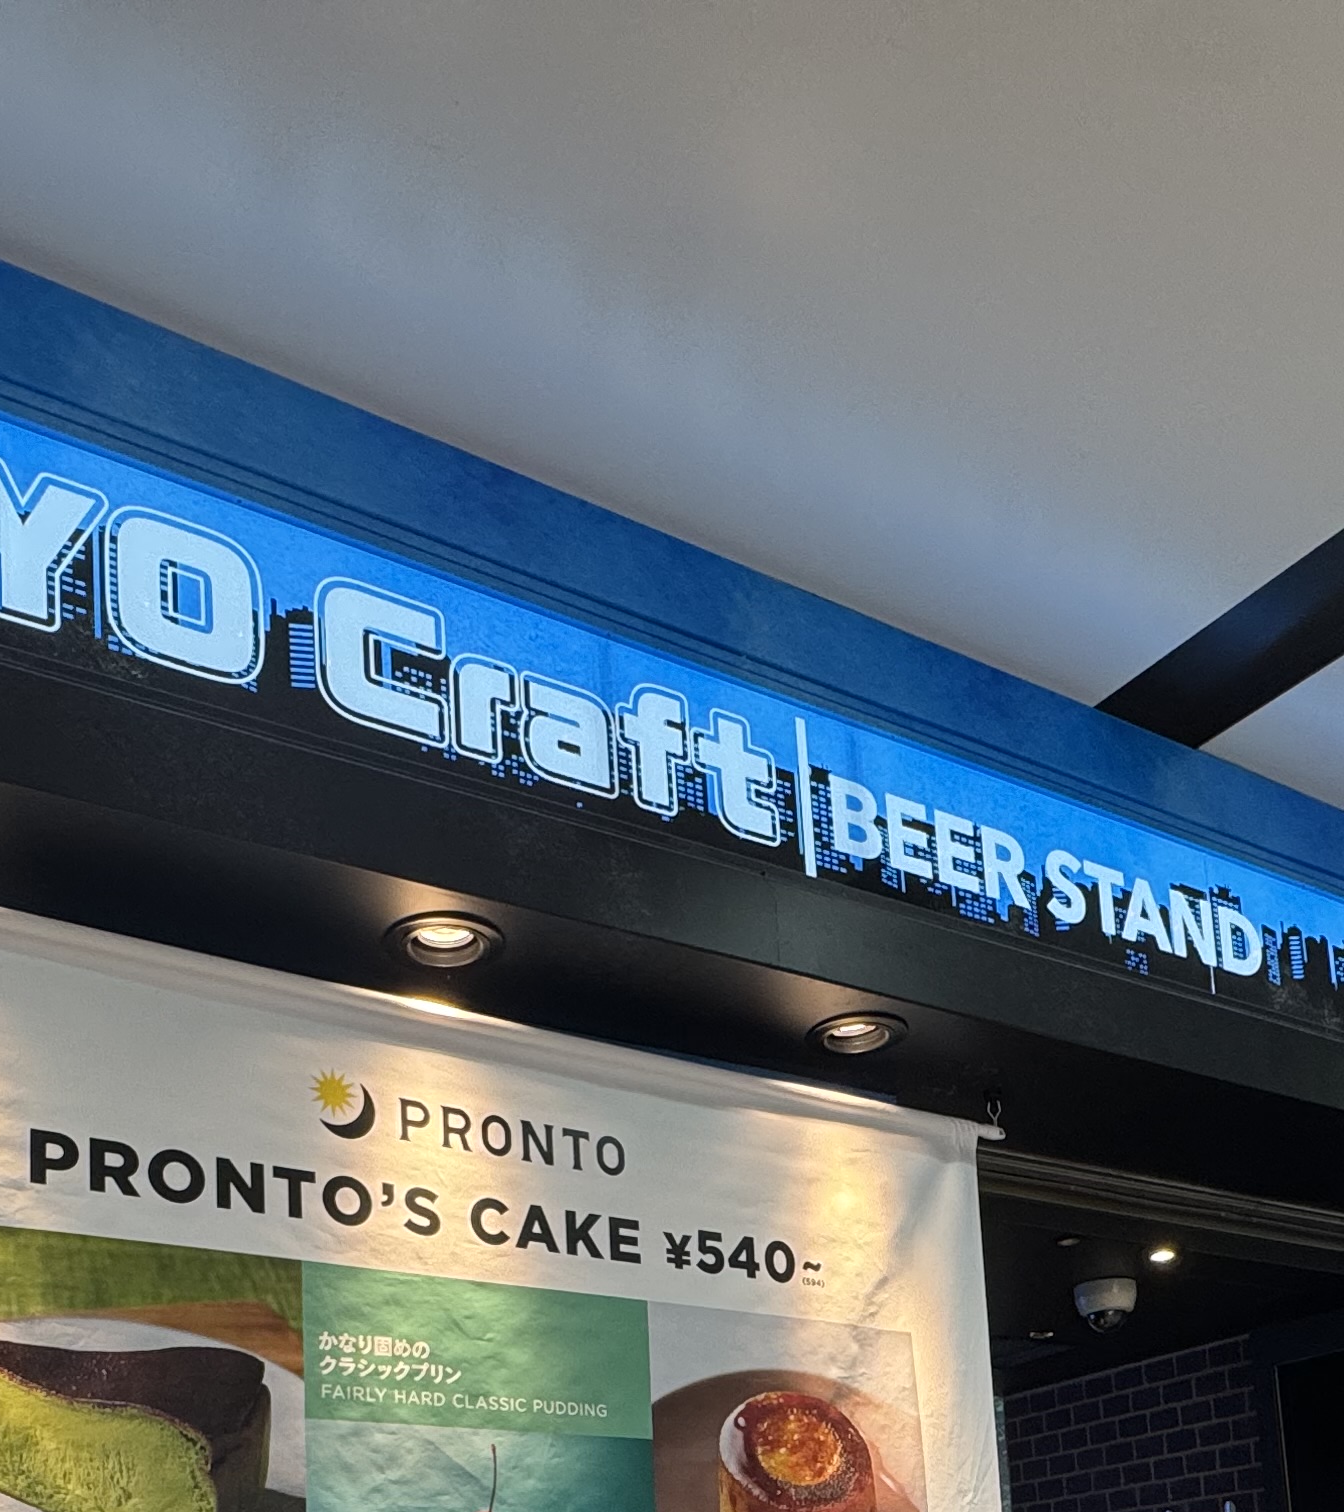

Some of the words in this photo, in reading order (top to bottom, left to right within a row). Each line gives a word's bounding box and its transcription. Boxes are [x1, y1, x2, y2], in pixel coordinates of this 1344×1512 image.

[313, 577, 782, 846] Craft
[827, 775, 1032, 911] BEER
[1044, 848, 1263, 977] STAND
[397, 1096, 627, 1176] PRONTO
[469, 1196, 642, 1265] CAKE
[802, 1277, 825, 1288] (594)
[318, 1331, 430, 1359] かなり固めの
[319, 1356, 462, 1384] クラシックプリン
[321, 1384, 386, 1402] FAIRLY
[394, 1389, 446, 1407] HARD
[451, 1394, 526, 1412] CLASSIC
[533, 1401, 607, 1418] PUDDING
